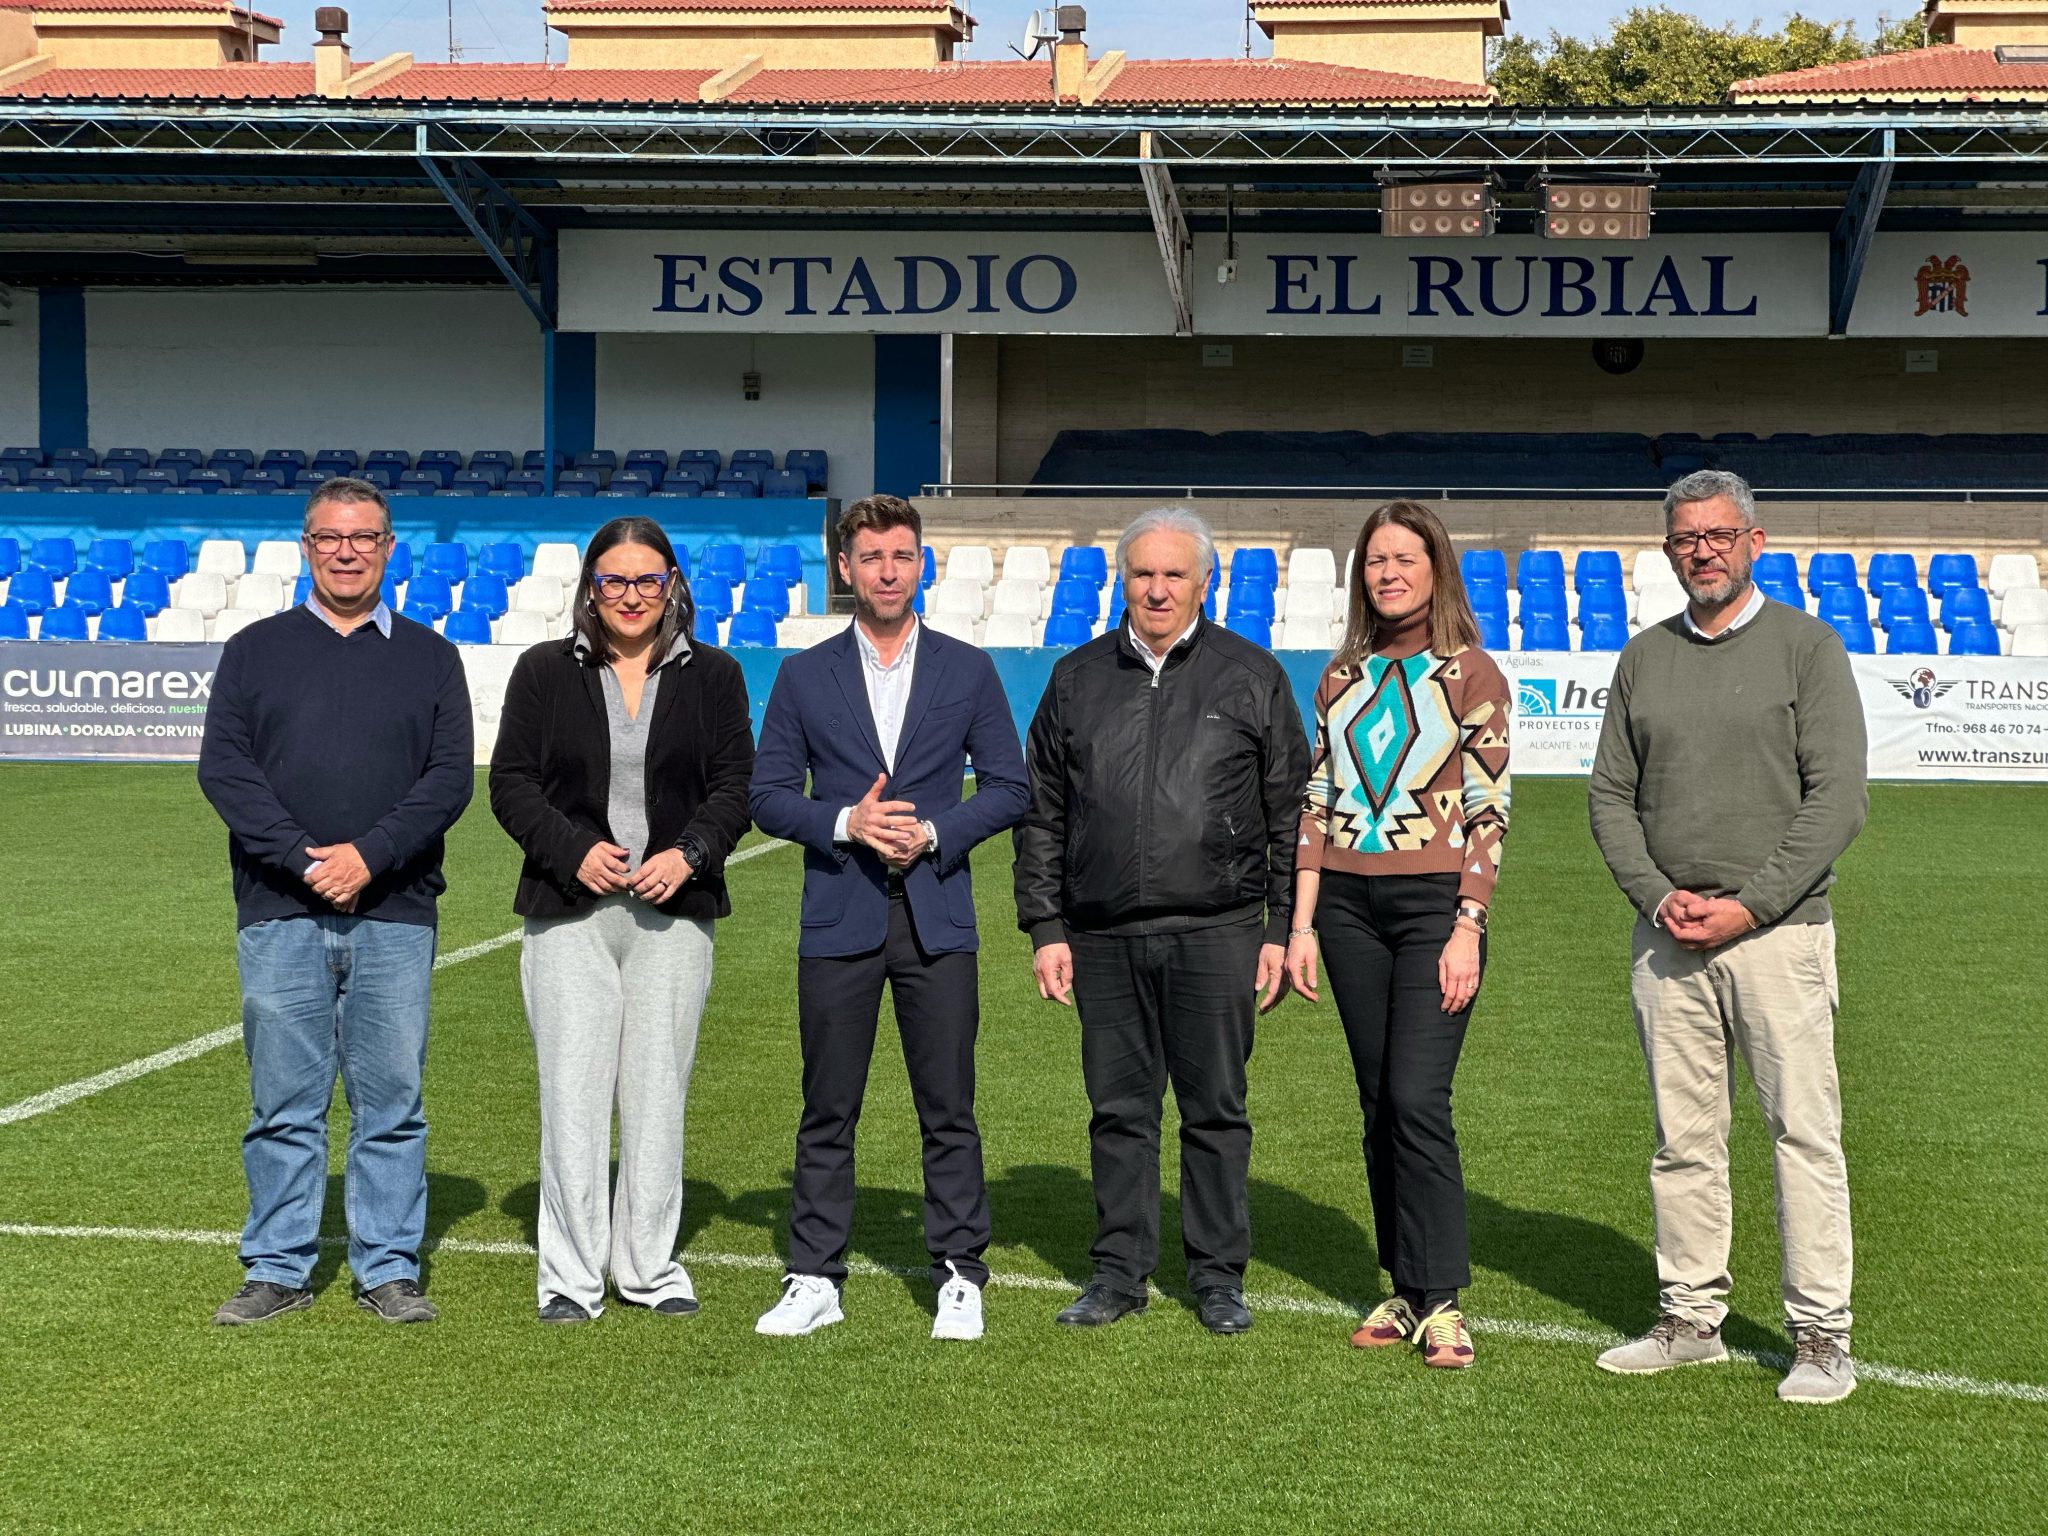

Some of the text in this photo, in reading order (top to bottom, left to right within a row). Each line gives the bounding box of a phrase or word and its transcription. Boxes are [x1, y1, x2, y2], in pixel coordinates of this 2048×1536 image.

[653, 254, 1758, 316] ESTADIO EL RUBIAL
[3, 669, 214, 698] culmarex
[1966, 680, 2048, 700] TRANS
[4, 702, 43, 713] fresca,
[46, 703, 107, 714] saludable,
[111, 703, 166, 714] deliciosa,
[1966, 703, 2022, 711] TRANSPORTES
[5, 724, 63, 736] LUBINA
[71, 724, 136, 737] DORADA
[1519, 721, 1590, 730] PROYECTOS
[1926, 723, 1960, 733] Tfno.:
[1963, 724, 1986, 734] 968
[1989, 724, 2006, 734] 46
[2009, 724, 2024, 735] 70
[2027, 724, 2041, 735] 74
[1530, 741, 1571, 750] ALICANTE
[1580, 741, 1597, 750] MU
